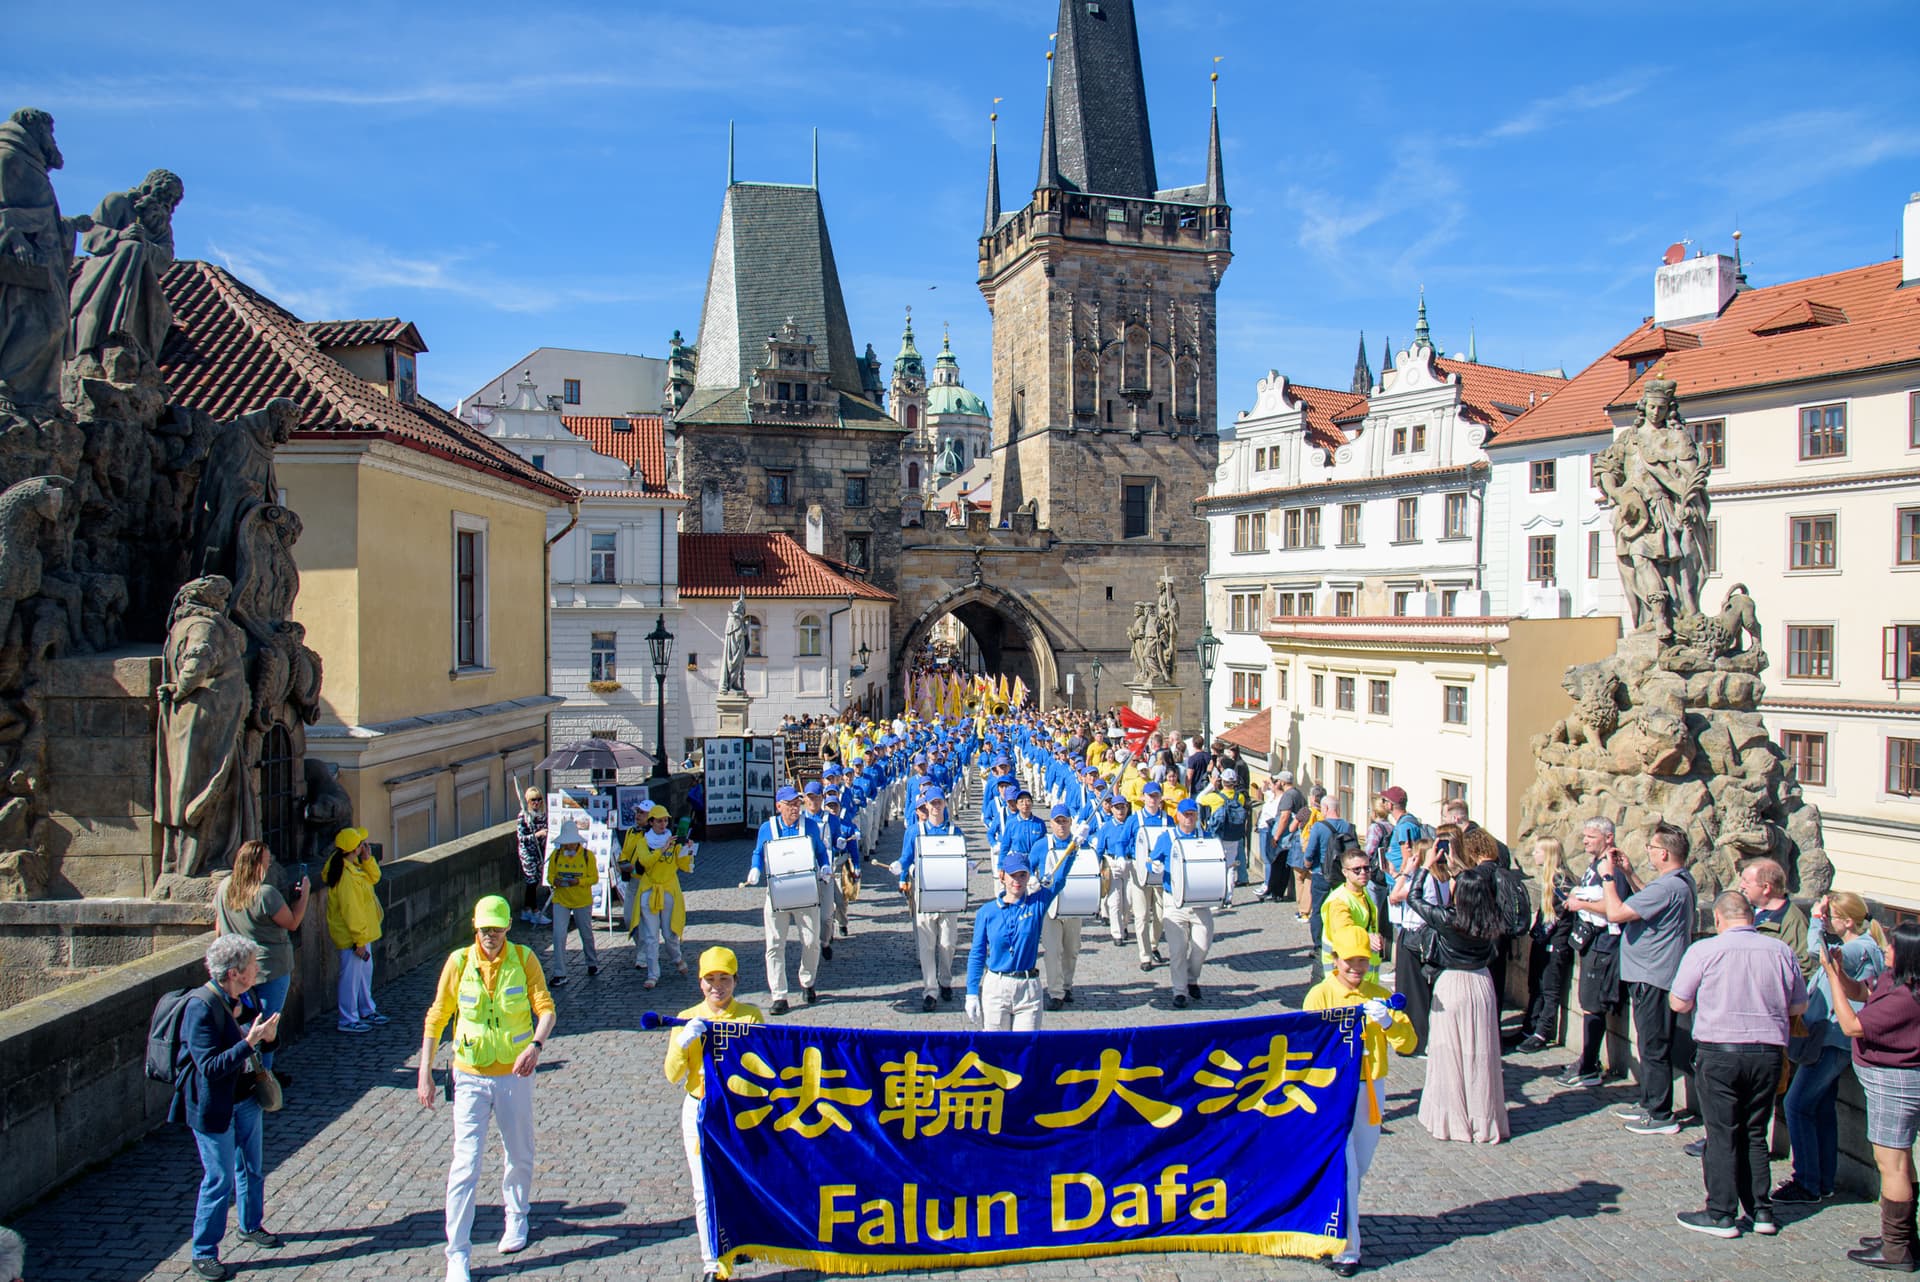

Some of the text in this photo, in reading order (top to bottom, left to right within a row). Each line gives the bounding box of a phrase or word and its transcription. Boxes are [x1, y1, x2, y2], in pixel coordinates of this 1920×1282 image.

[727, 1034, 1337, 1140] 法輪大法
[818, 1165, 1227, 1246] Falun Dafa
